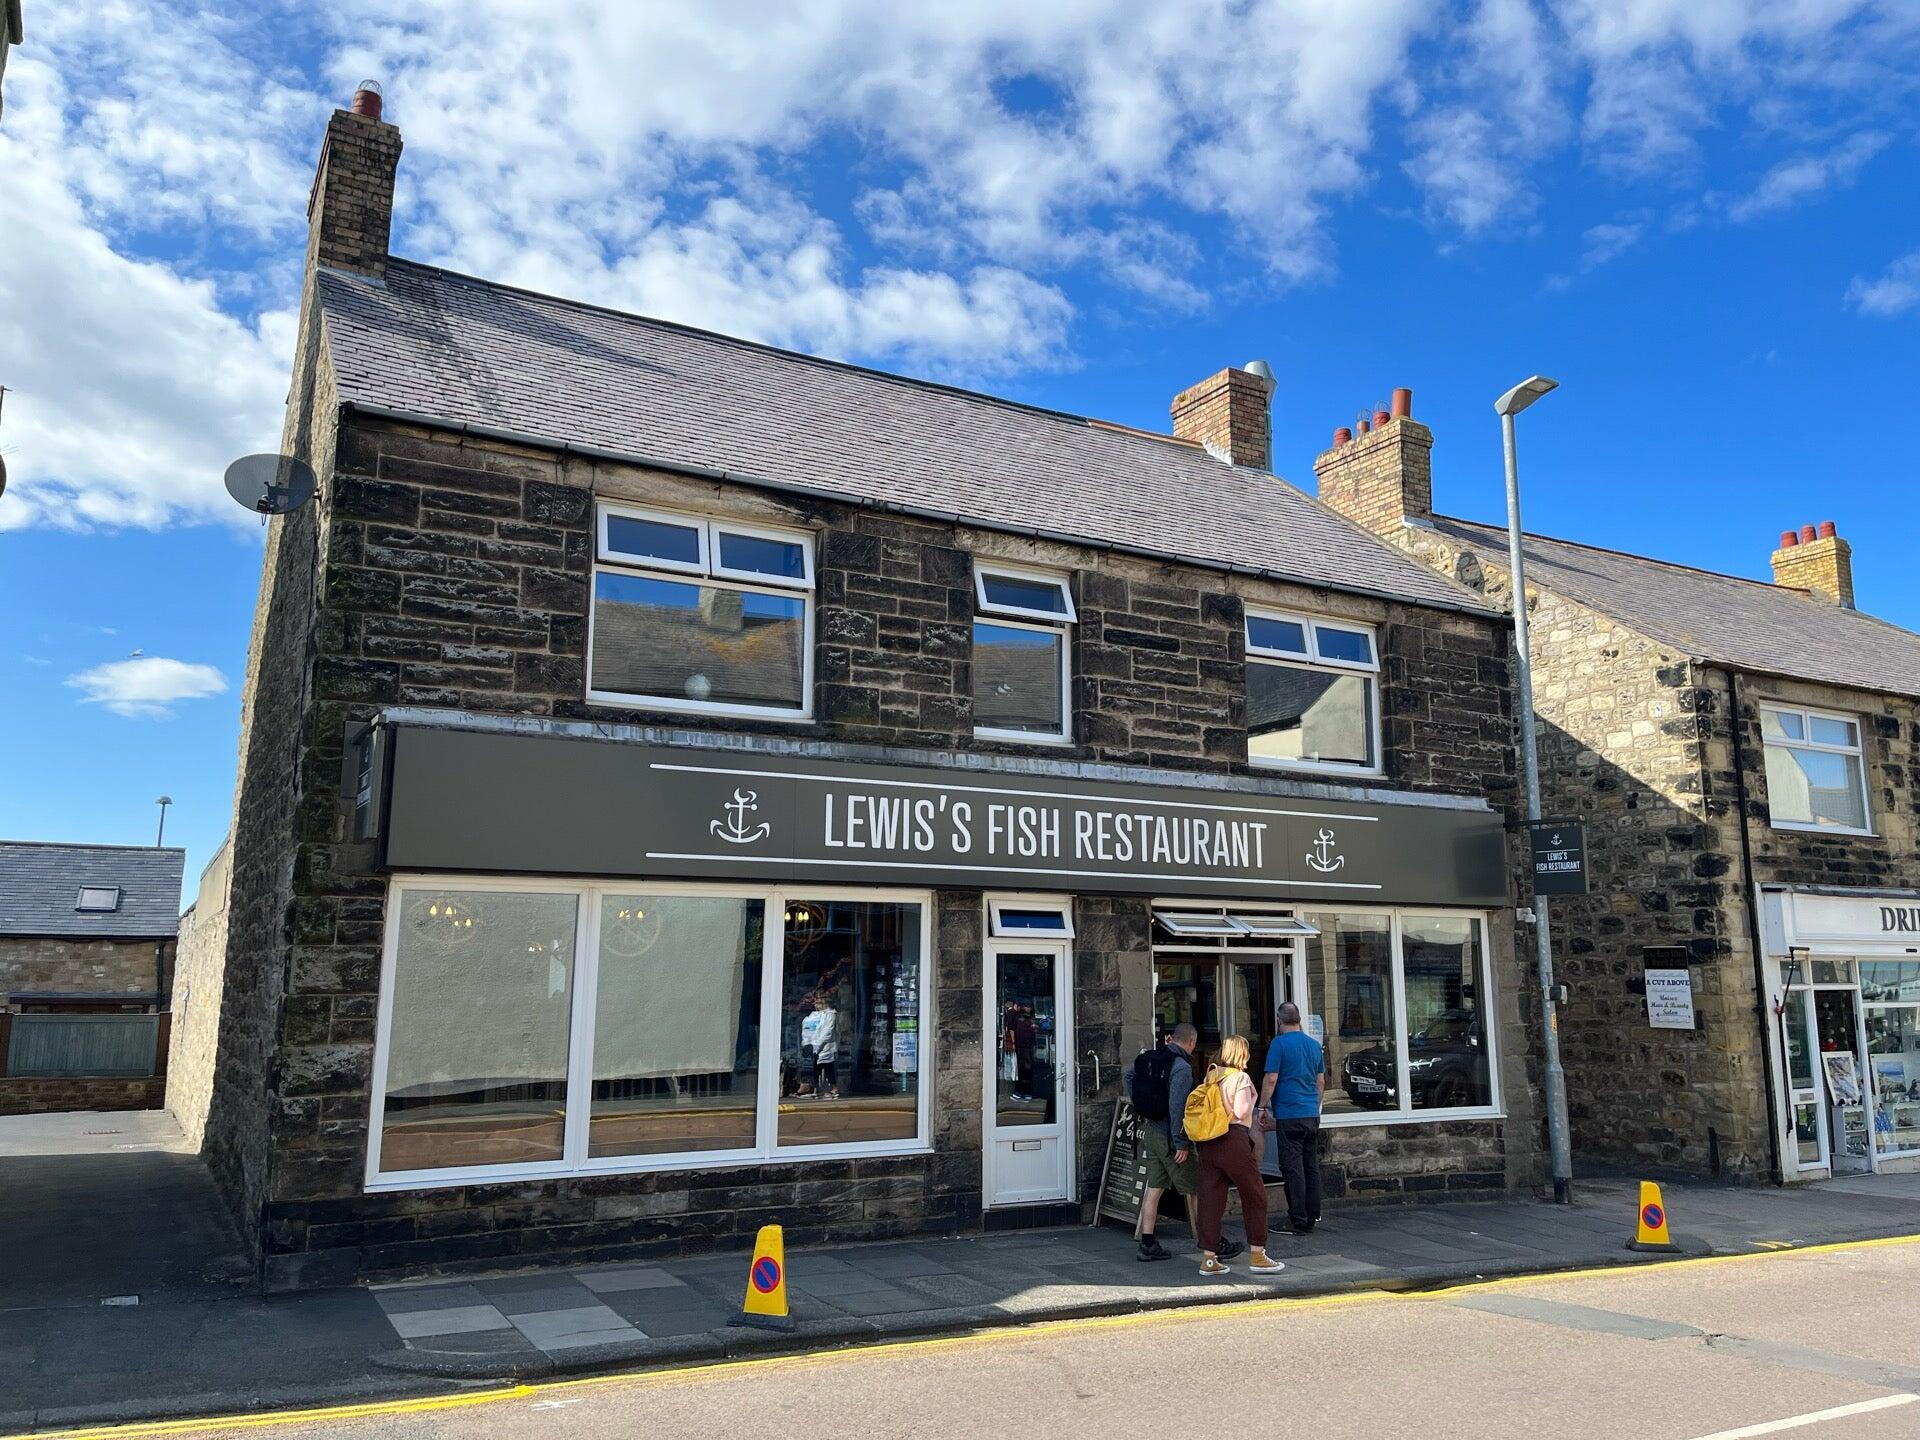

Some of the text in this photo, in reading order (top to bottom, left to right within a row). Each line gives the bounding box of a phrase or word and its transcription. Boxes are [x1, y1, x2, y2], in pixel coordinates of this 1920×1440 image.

[824, 793, 1267, 868] LEWIS'S FISH RESTAURANT
[1547, 852, 1568, 860] LEWIS'S
[1536, 861, 1580, 871] FISH RESTAURANT
[1879, 906, 1920, 932] DRI
